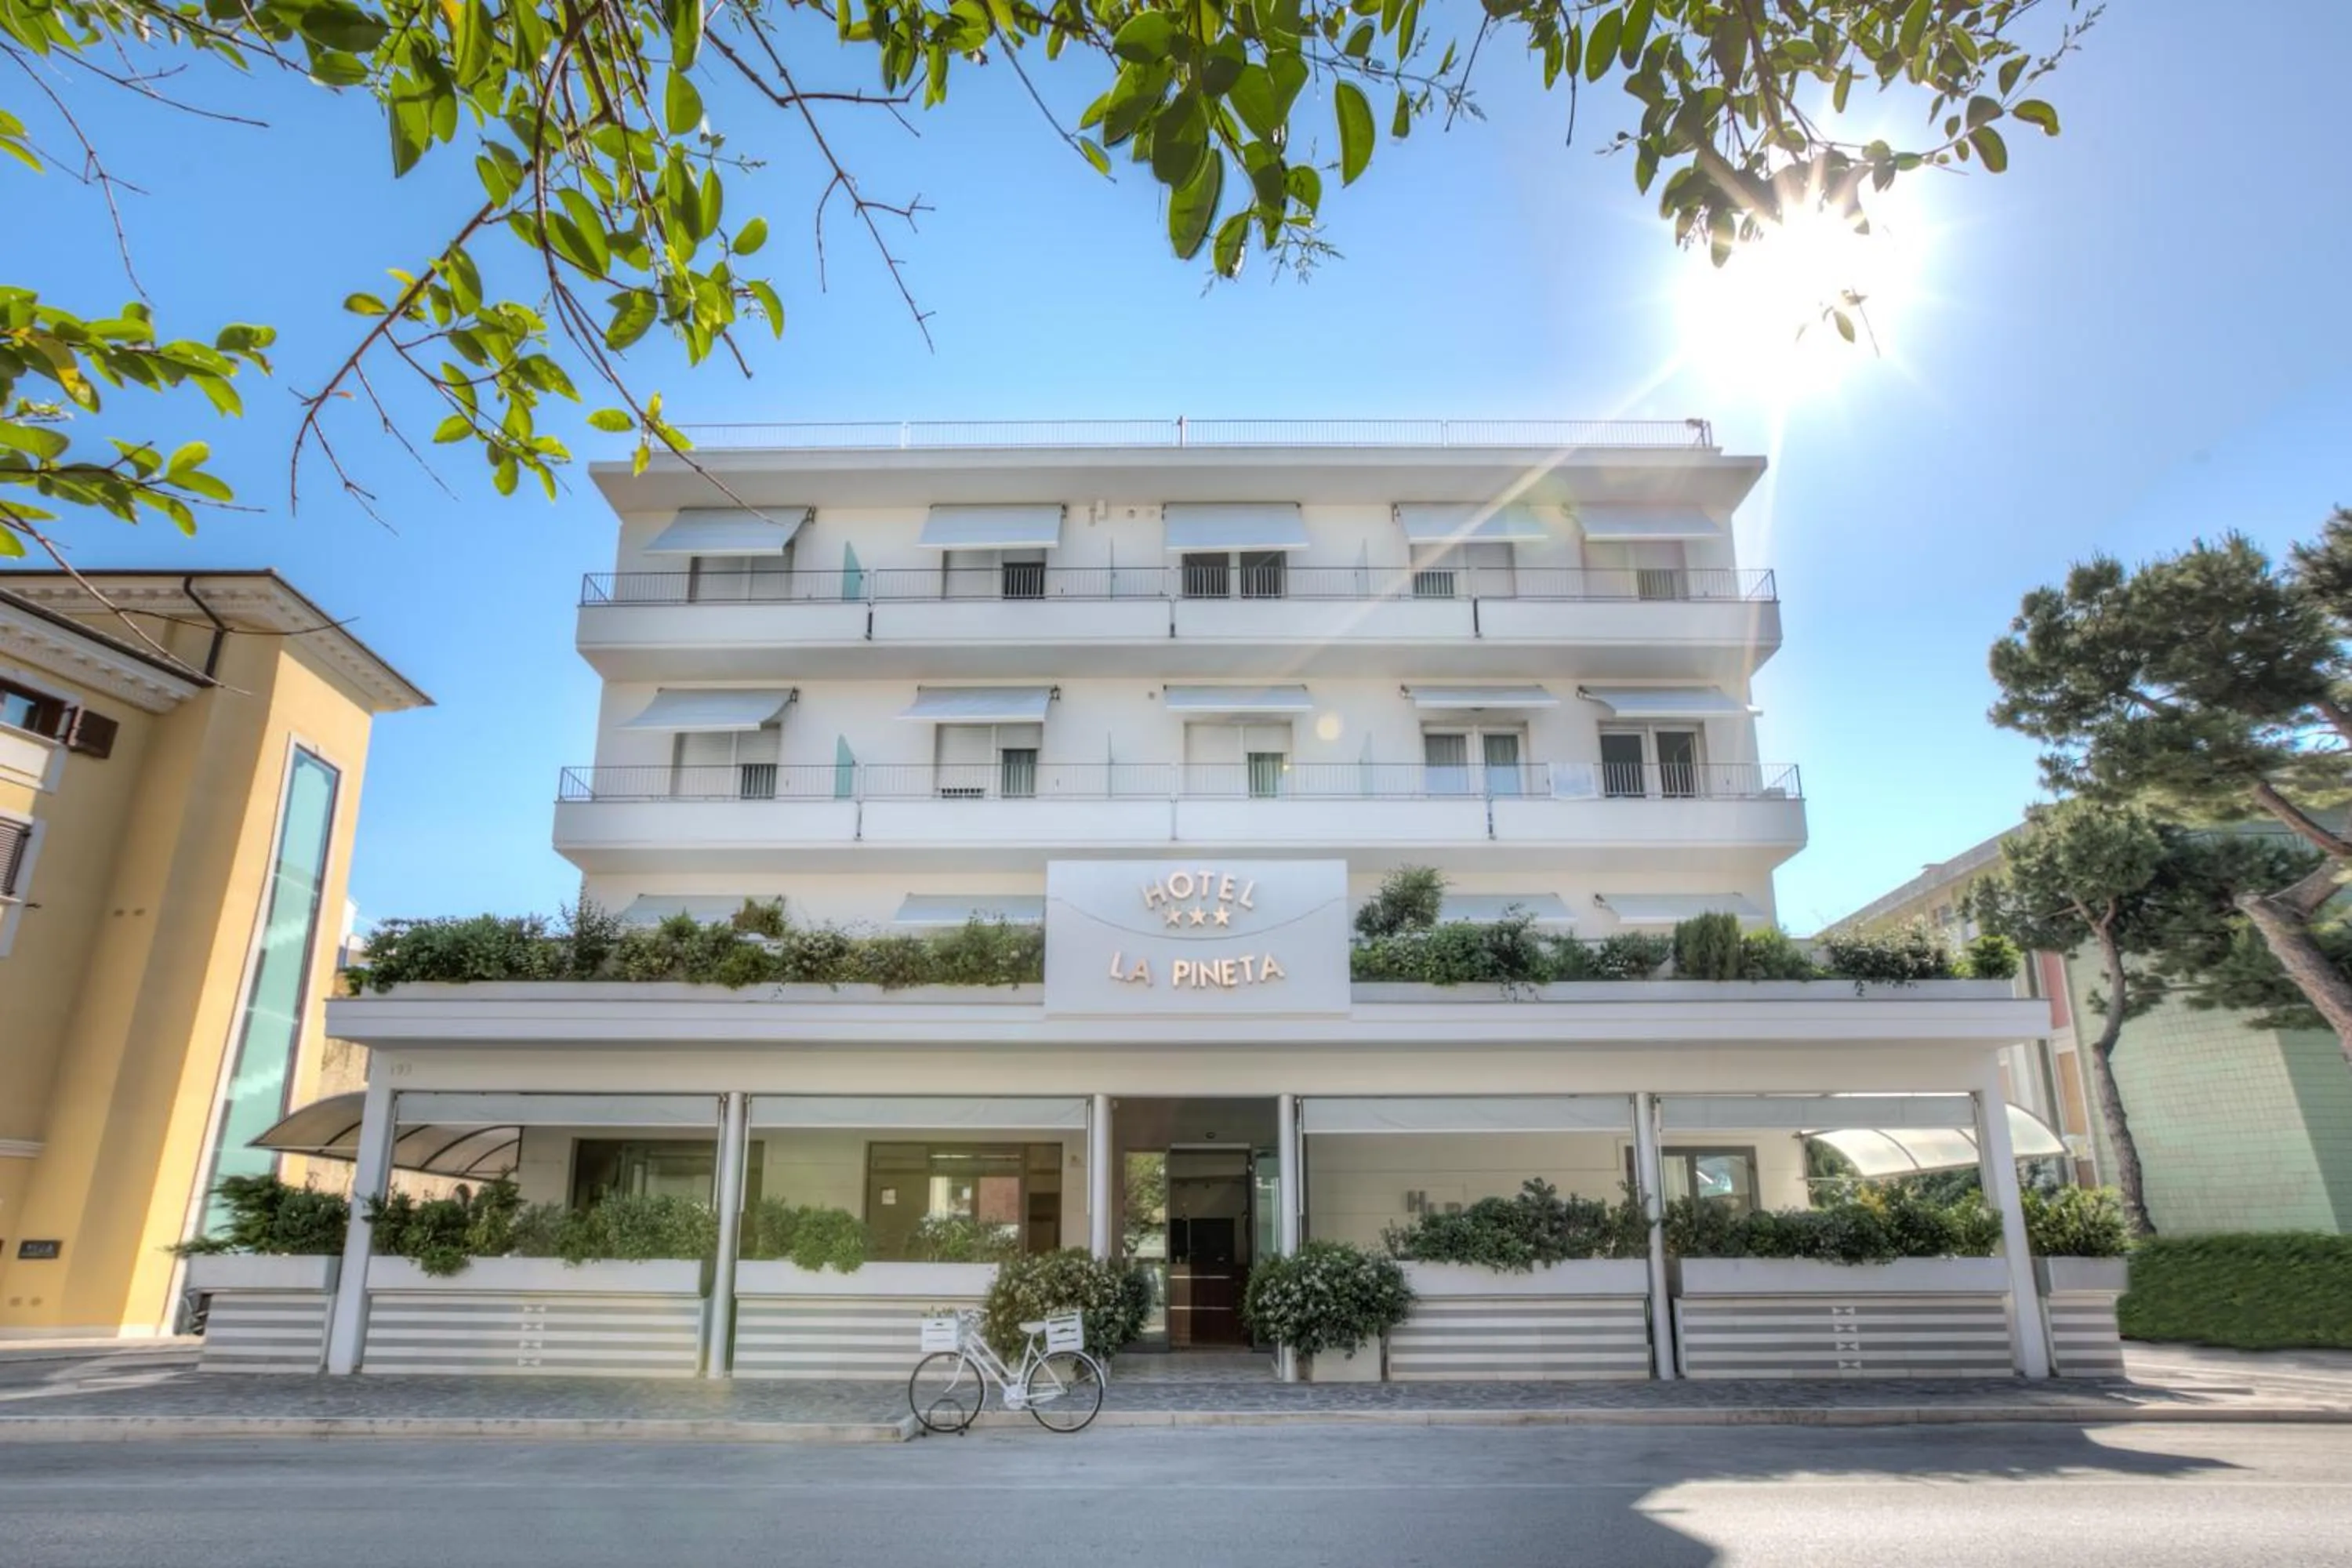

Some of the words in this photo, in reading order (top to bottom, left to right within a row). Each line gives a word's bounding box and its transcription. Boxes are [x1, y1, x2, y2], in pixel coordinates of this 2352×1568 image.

[1141, 869, 1255, 909] HOTEL
[1109, 951, 1153, 986] LA
[1172, 953, 1286, 987] PINETA
